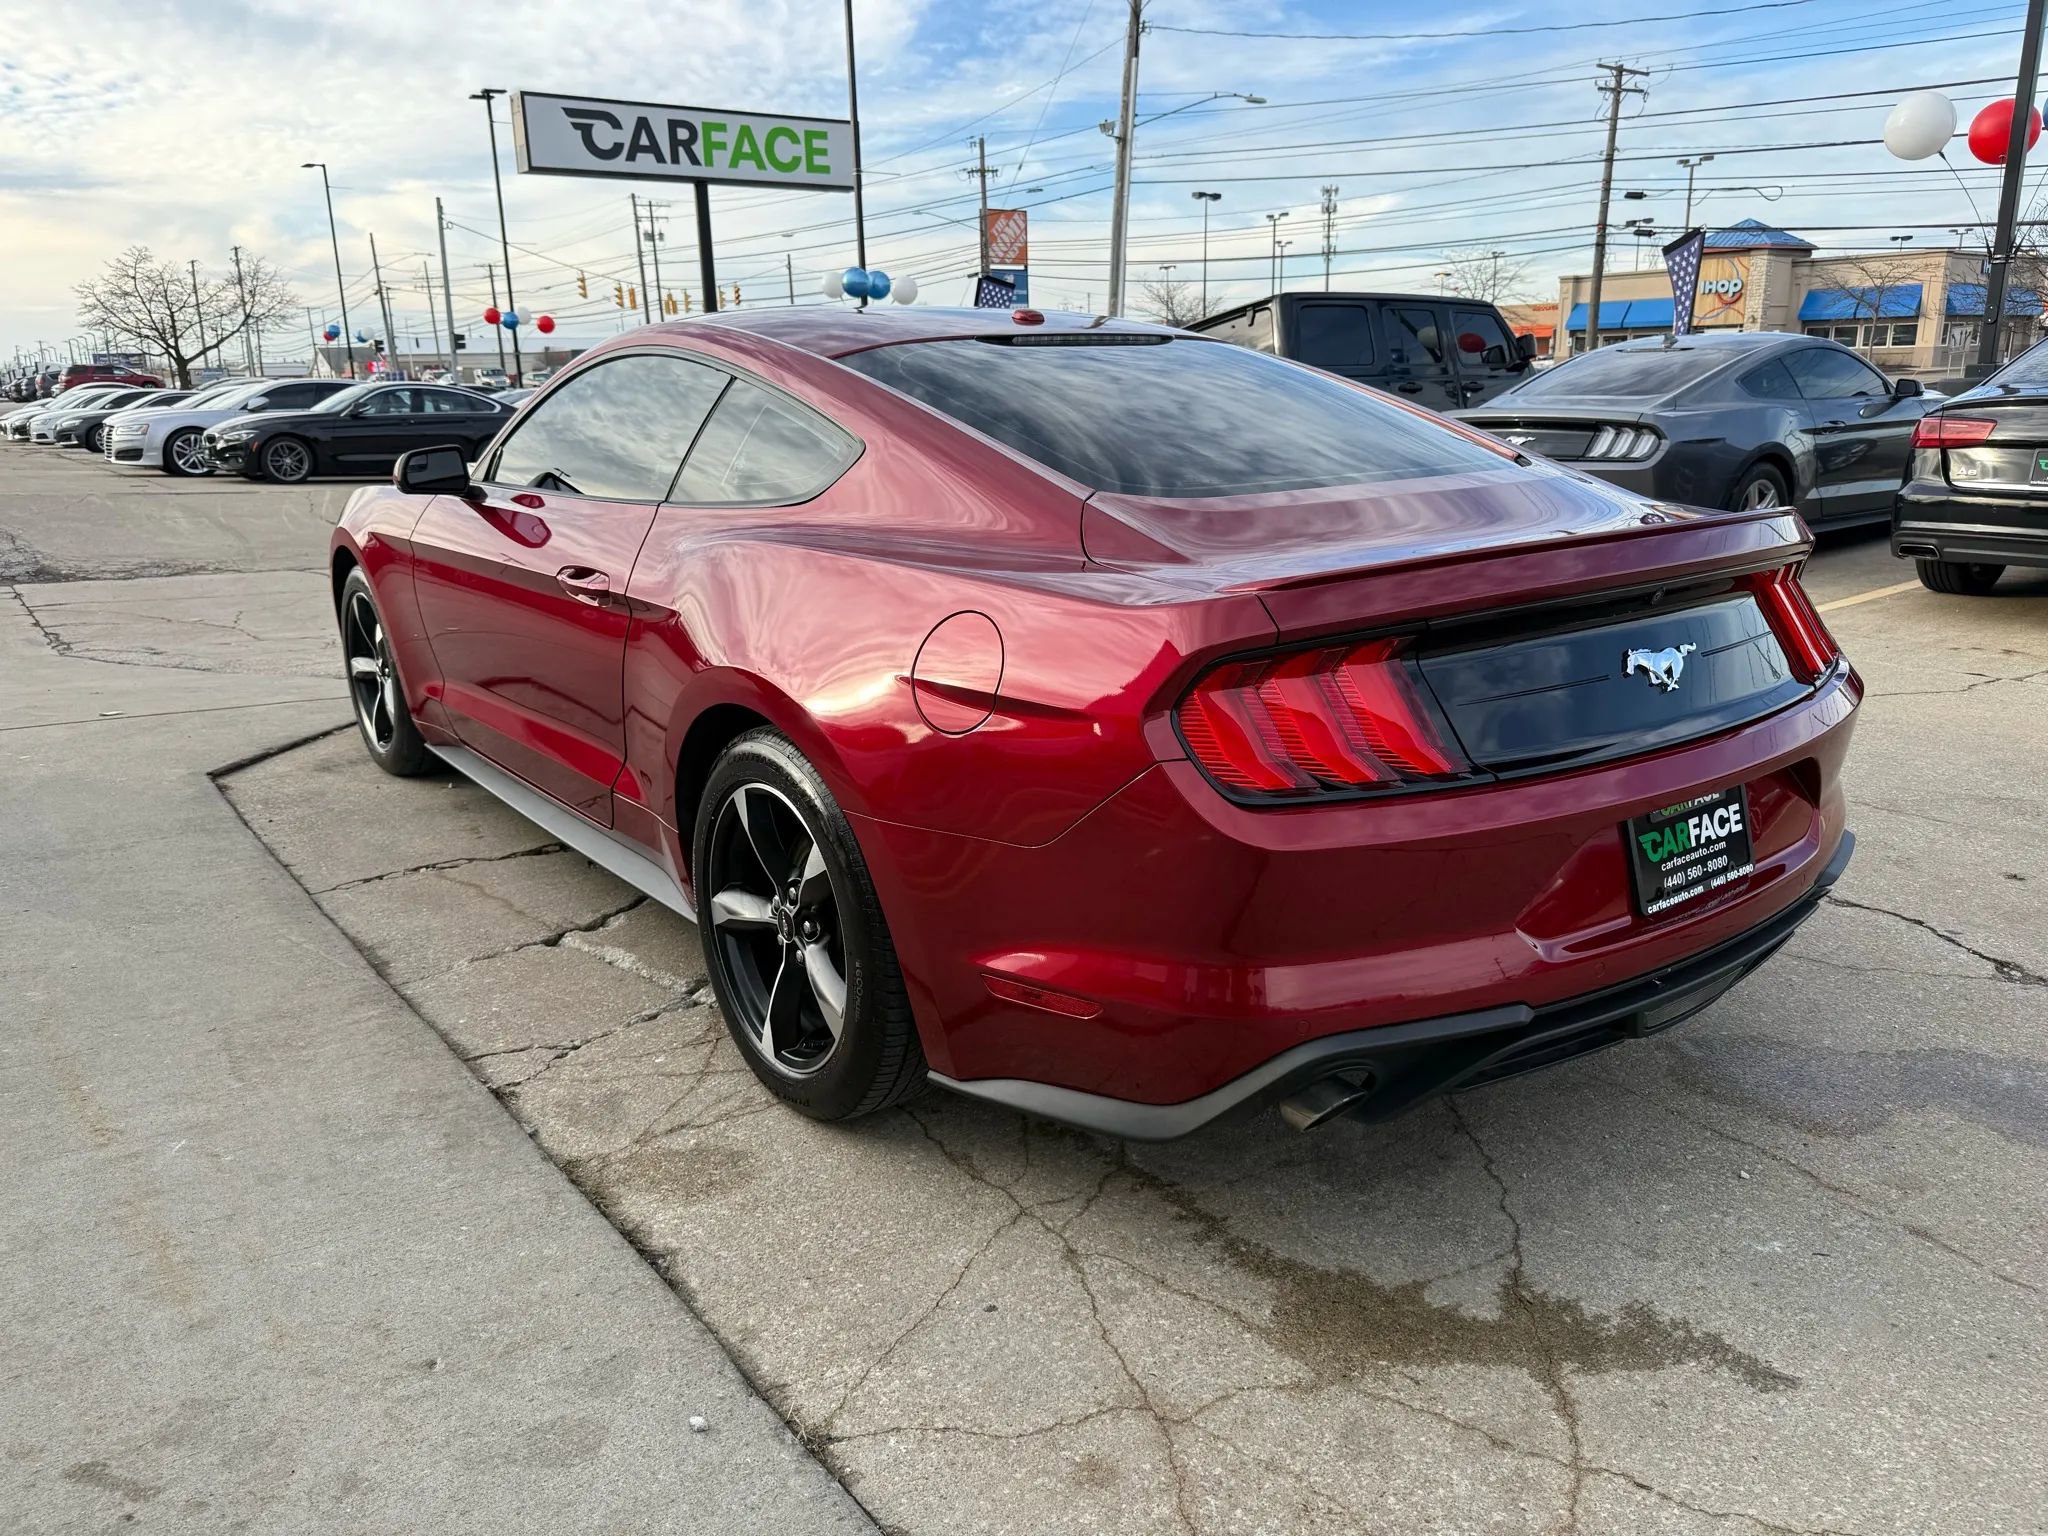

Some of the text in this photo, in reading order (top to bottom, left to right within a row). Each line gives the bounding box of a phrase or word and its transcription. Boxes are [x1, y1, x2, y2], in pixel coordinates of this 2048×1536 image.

[561, 107, 831, 174] CARFACE
[1638, 803, 1743, 862] CARFACE
[1661, 841, 1727, 871] carfaceauto.com
[1647, 885, 1704, 914] carfaceauto.com
[1710, 873, 1727, 890] (440)
[1664, 871, 1686, 888] (440)
